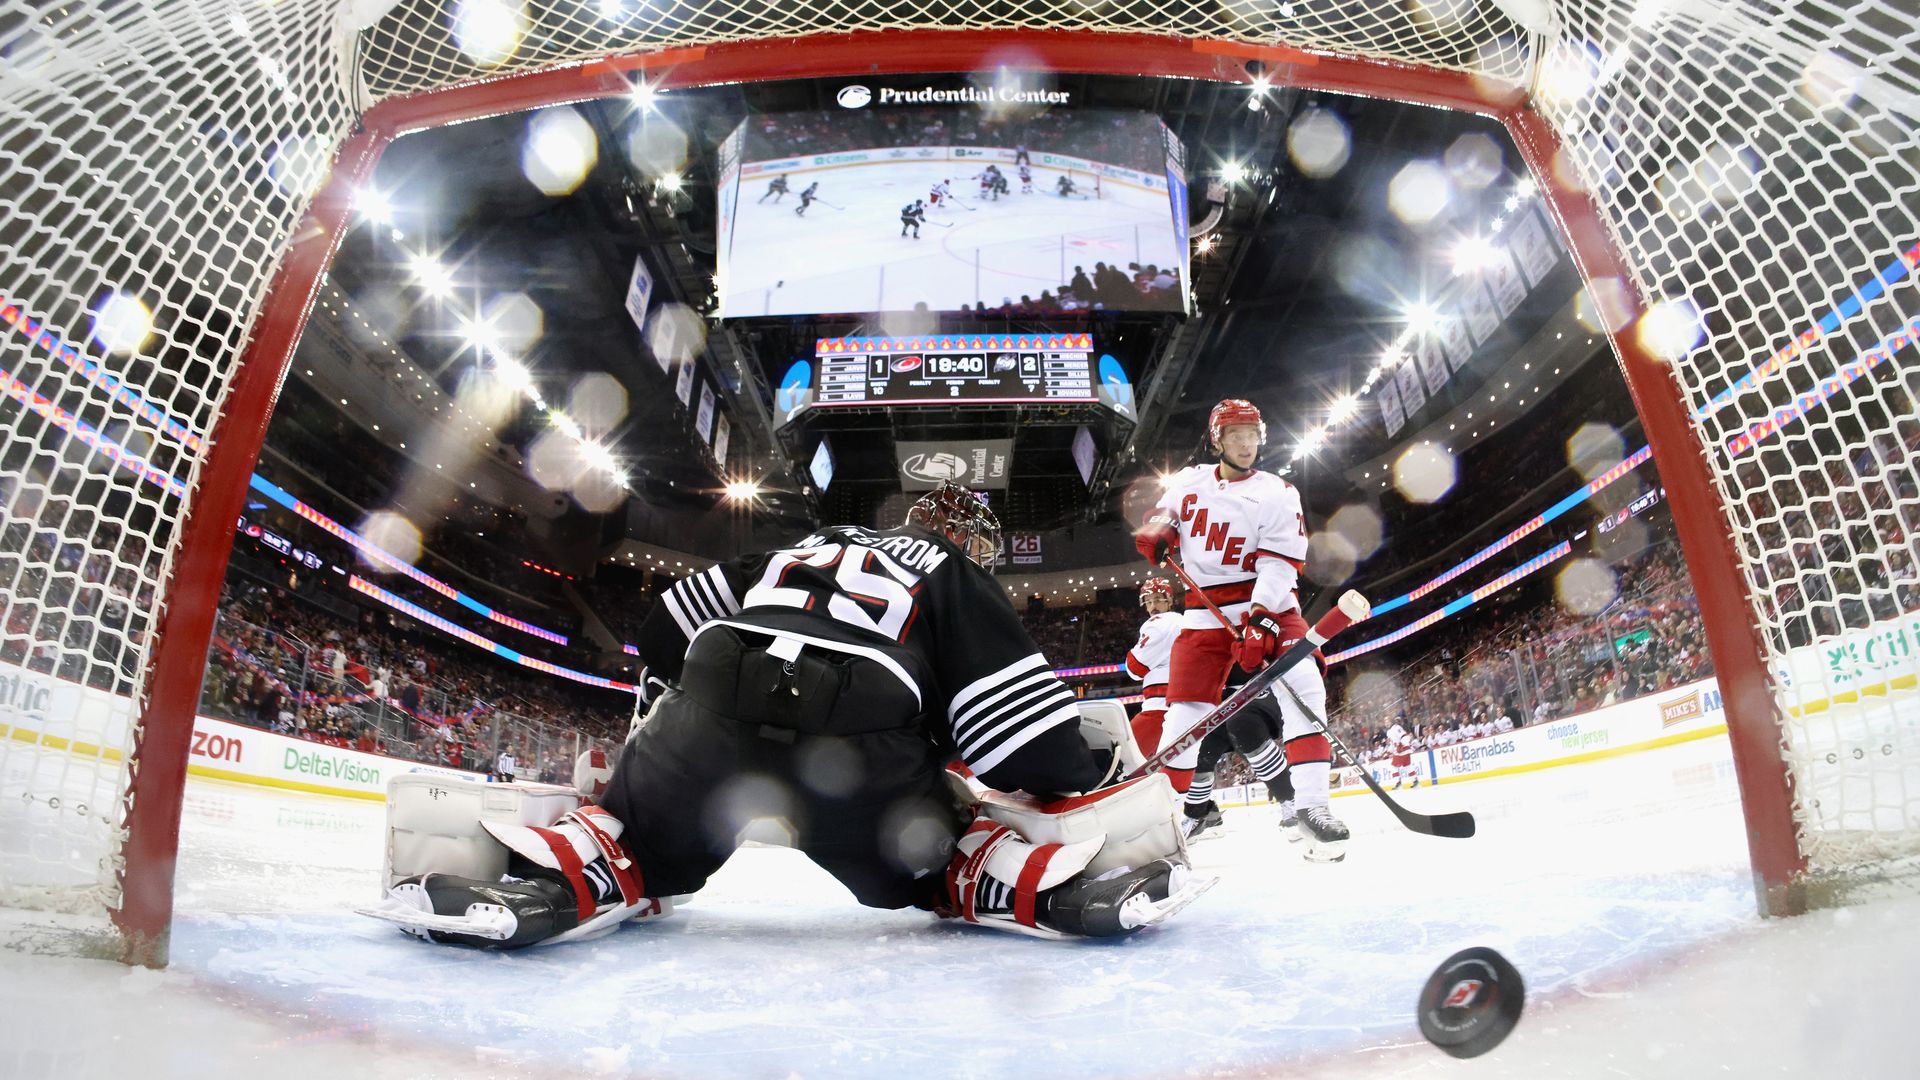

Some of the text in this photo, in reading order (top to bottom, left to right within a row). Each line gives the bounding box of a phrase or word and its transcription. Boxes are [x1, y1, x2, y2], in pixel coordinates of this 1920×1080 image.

[880, 87, 1070, 103] Prudential Center
[875, 359, 883, 374] 1
[1023, 356, 1036, 371] 2
[872, 387, 884, 395] 10
[950, 386, 959, 396] 2
[1028, 384, 1035, 392] 7
[970, 448, 987, 484] Prudential
[989, 454, 1005, 478] Center
[1015, 535, 1038, 553] 26
[742, 543, 917, 642] 25
[1664, 699, 1698, 720] MIKE'S
[1144, 733, 1197, 776] CCM
[1220, 701, 1238, 717] PRO
[1547, 723, 1579, 740] choose
[1440, 738, 1516, 765] RWJBarnabas
[284, 747, 380, 785] DeltaVision
[1451, 760, 1482, 774] HEALTH
